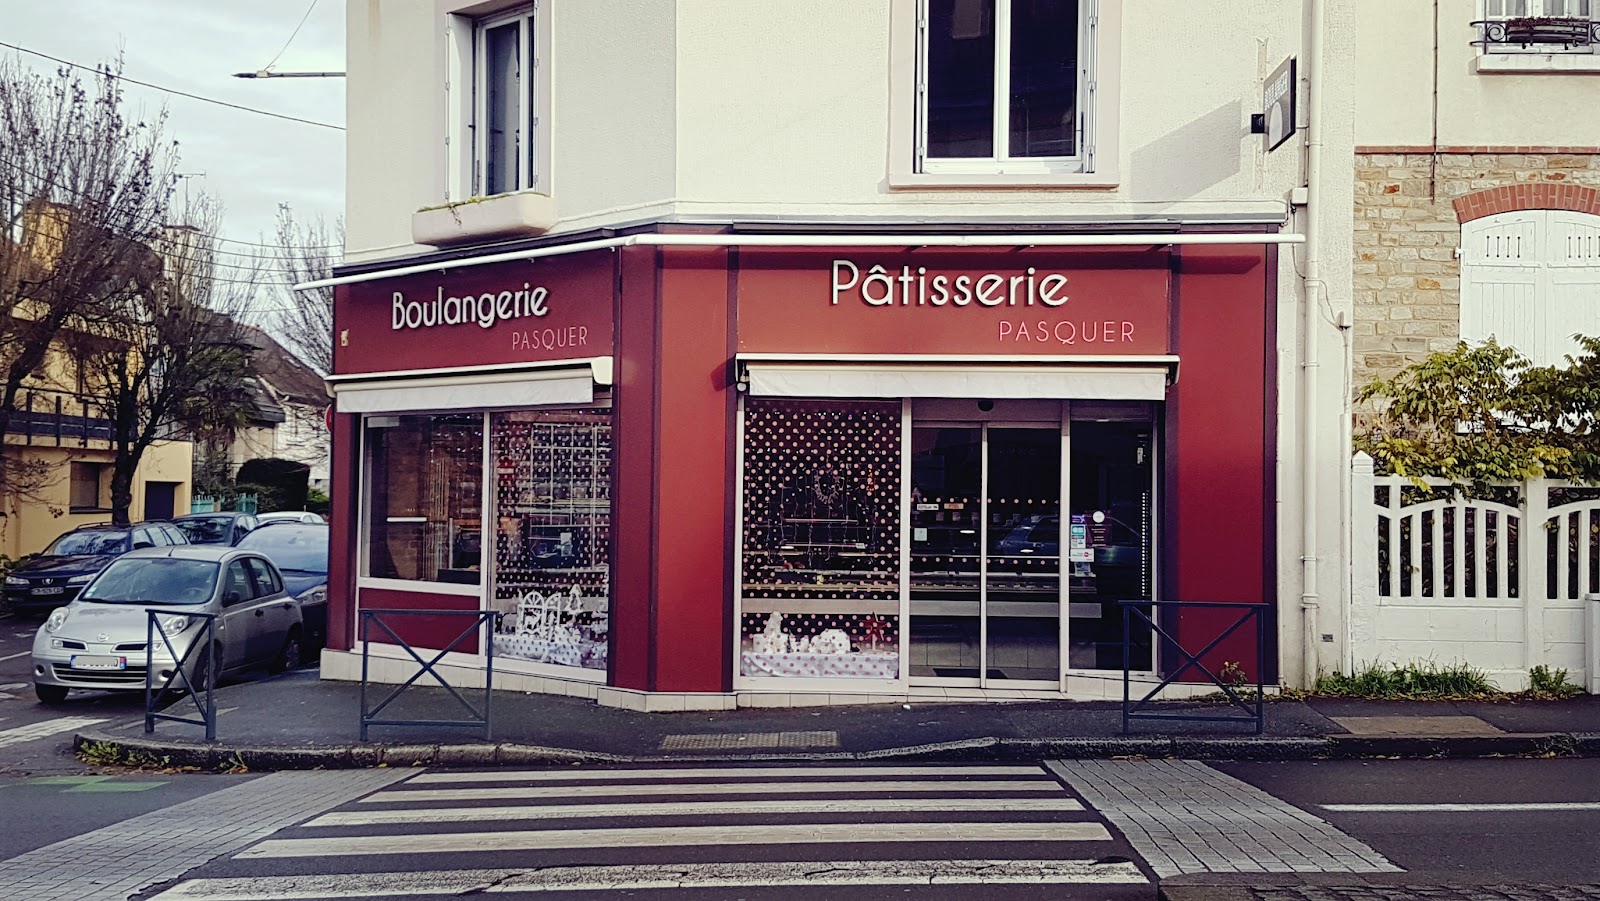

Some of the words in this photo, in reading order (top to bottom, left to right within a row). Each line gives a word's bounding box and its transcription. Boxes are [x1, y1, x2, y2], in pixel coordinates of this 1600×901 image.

[832, 259, 1069, 306] Pâtisserie
[392, 282, 548, 330] Boulangerie
[511, 326, 588, 351] PASQUER
[999, 321, 1135, 345] PASQUER
